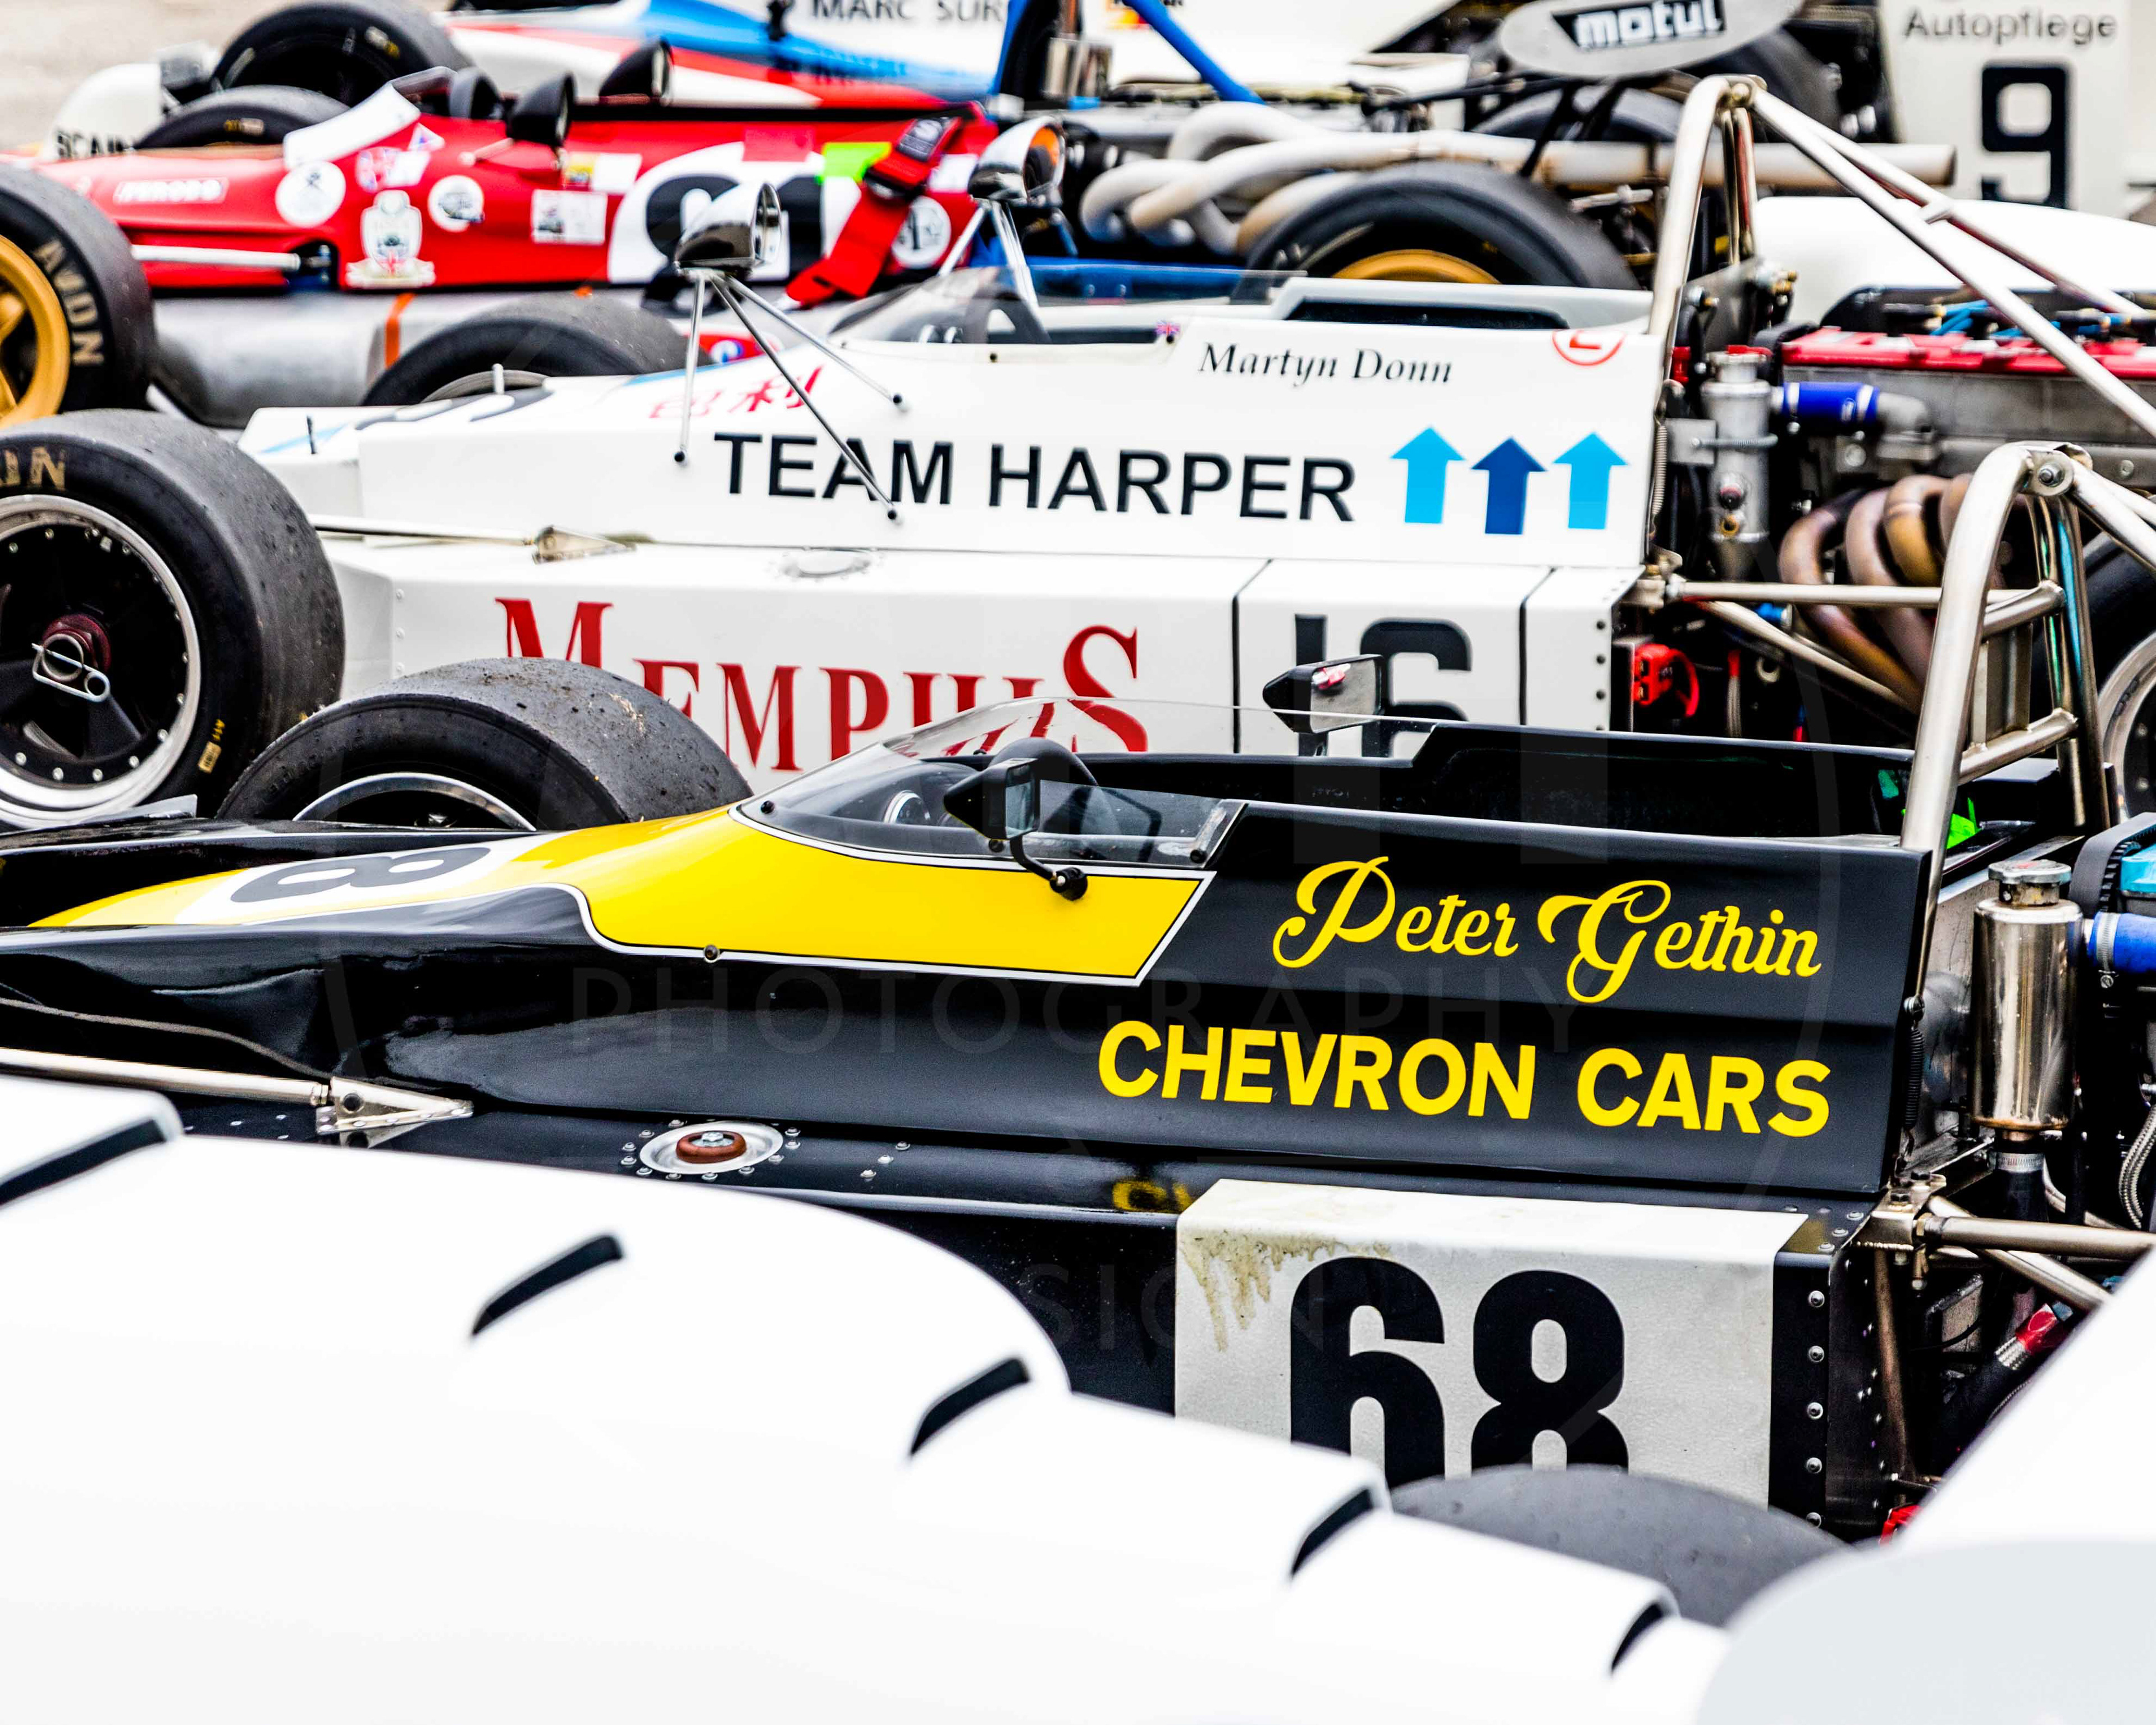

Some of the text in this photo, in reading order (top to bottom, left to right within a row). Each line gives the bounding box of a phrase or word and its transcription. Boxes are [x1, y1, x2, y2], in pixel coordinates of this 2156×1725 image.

[1904, 8, 2117, 45] Autopflege
[1981, 65, 2068, 209] 9
[33, 239, 106, 365] AVON
[1198, 342, 1453, 387] Martyn Donn
[714, 432, 1356, 522] TEAM HARPER
[230, 847, 490, 903] 8
[1272, 856, 1822, 1004] Peter Gethin
[1098, 1019, 1831, 1137] CHEVRON CARS
[1290, 1255, 1630, 1489] 68
